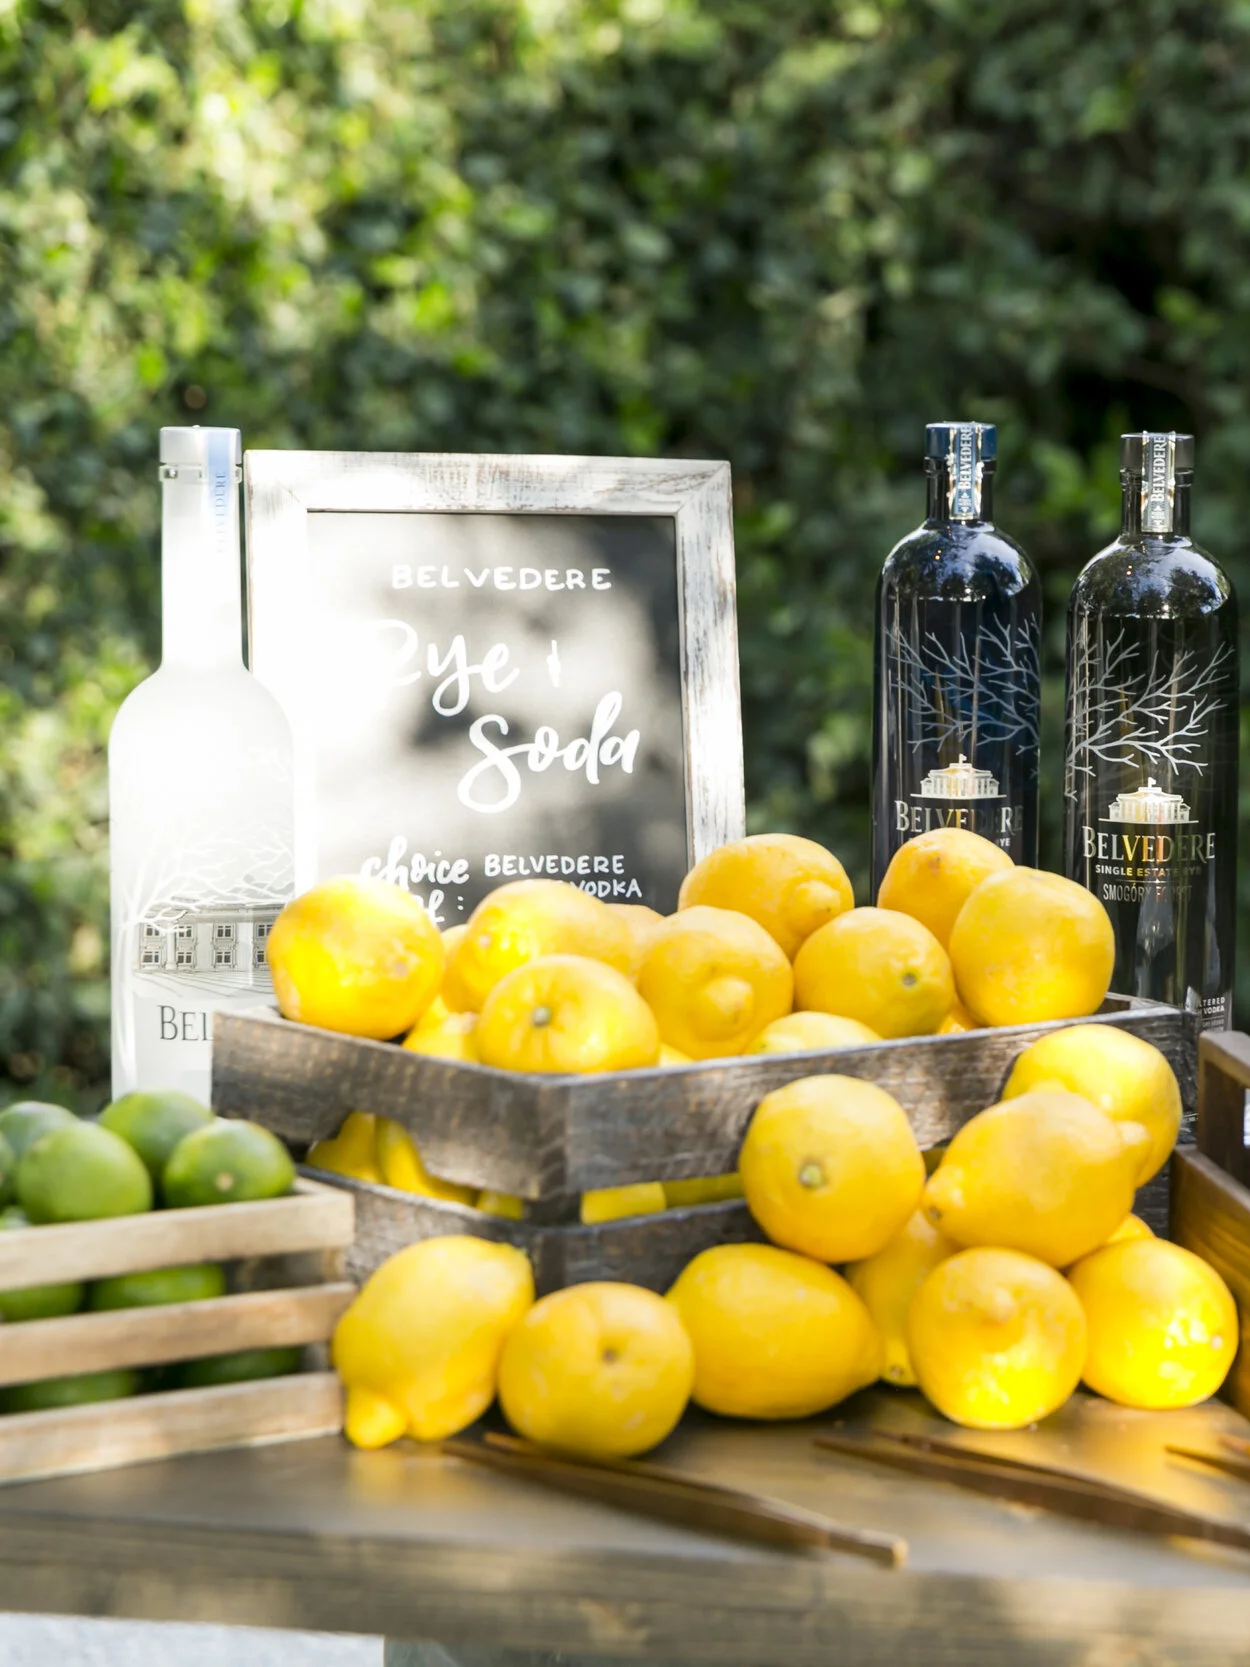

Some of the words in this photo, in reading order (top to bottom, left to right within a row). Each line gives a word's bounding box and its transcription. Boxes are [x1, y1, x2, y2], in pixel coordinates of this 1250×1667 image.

[957, 425, 972, 490] BELVEDERE
[1150, 436, 1167, 502] BELVEDERE
[391, 564, 613, 591] BELVEDERE
[457, 691, 641, 813] Soda
[894, 800, 1024, 835] BELVEDRE
[1082, 826, 1217, 864] BELVEDERE
[360, 836, 470, 891] choice
[484, 854, 625, 878] BELVEDERE
[1095, 864, 1134, 877] SINGLE
[569, 878, 643, 899] VODKA
[1203, 1005, 1225, 1015] VODKA
